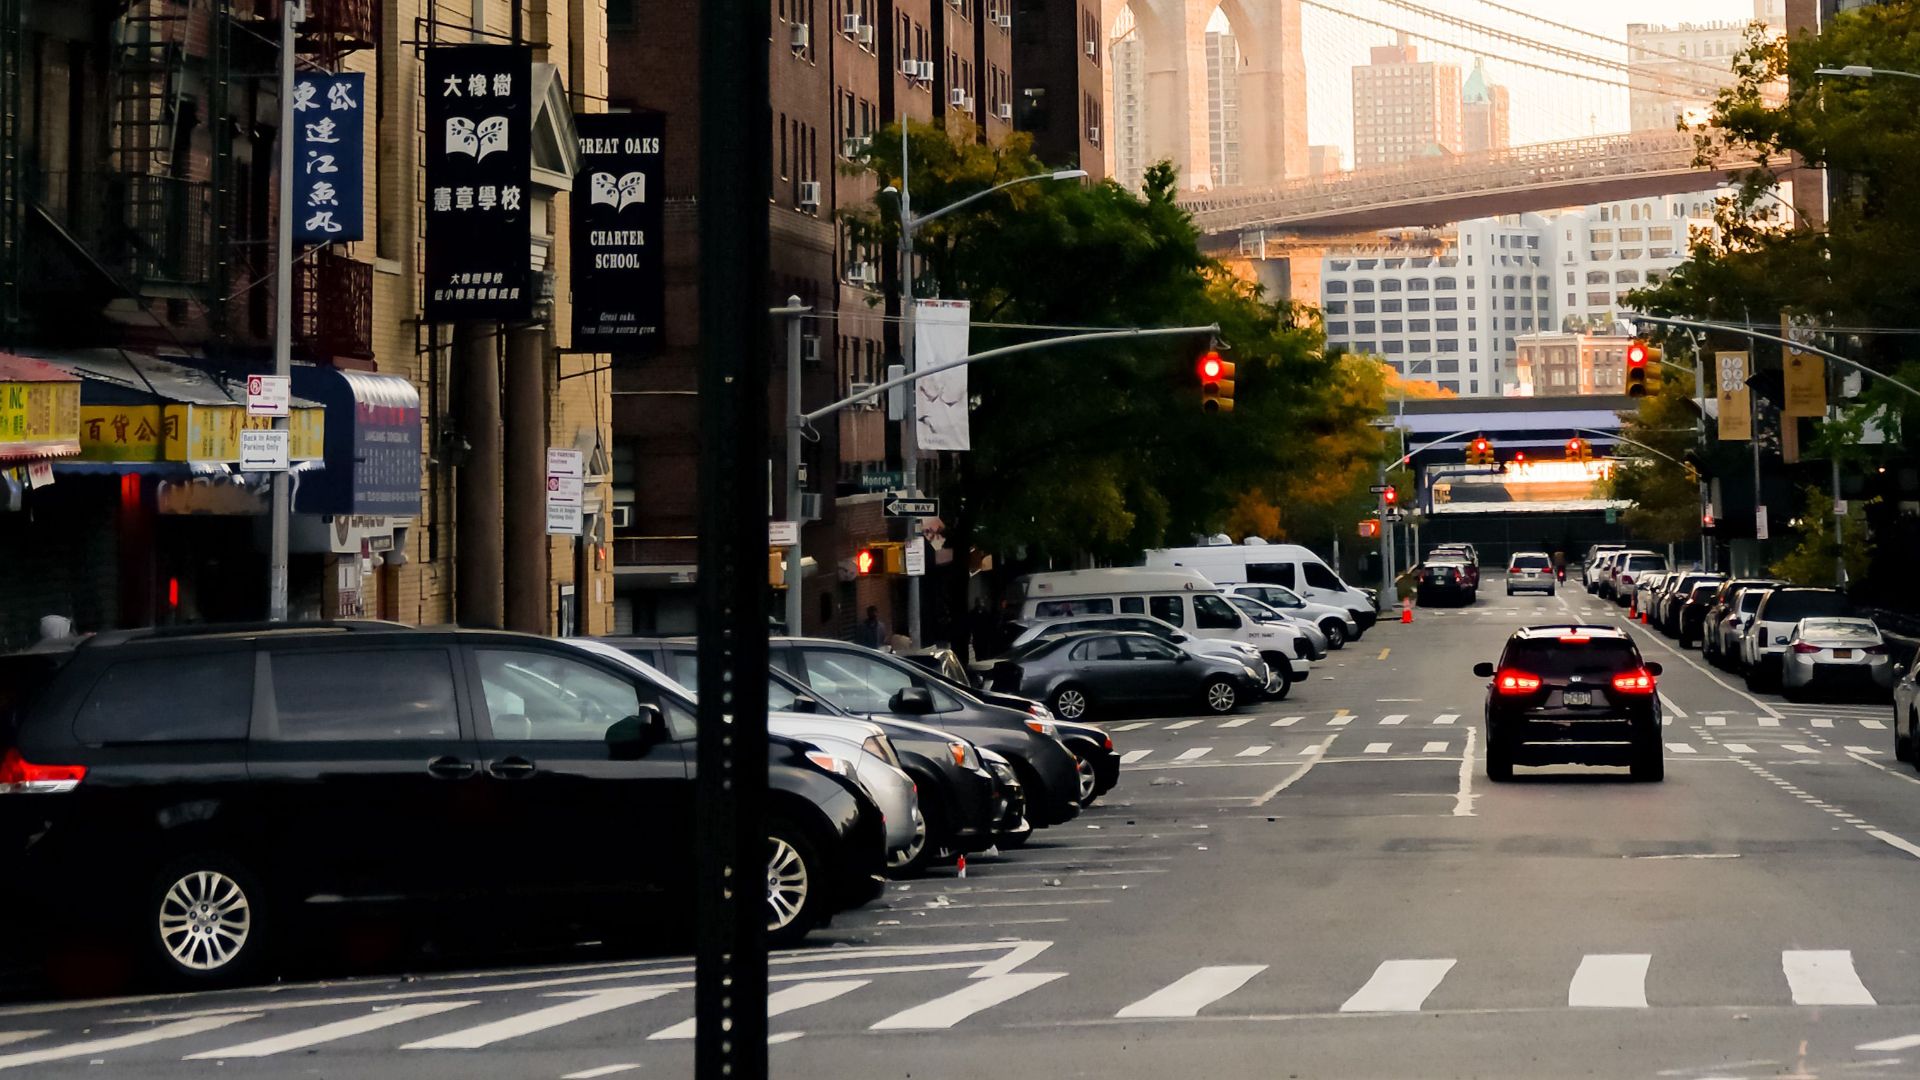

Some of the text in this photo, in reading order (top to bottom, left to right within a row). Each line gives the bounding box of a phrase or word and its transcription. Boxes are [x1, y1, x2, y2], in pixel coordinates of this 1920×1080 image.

[443, 73, 512, 97] 大橡樹
[625, 138, 659, 154] OAKS
[433, 185, 521, 211] 憲章學校
[590, 231, 644, 246] CHARTER
[595, 254, 640, 269] SCHOOL
[84, 413, 179, 444] 百貨公司
[862, 475, 892, 486] Monroe
